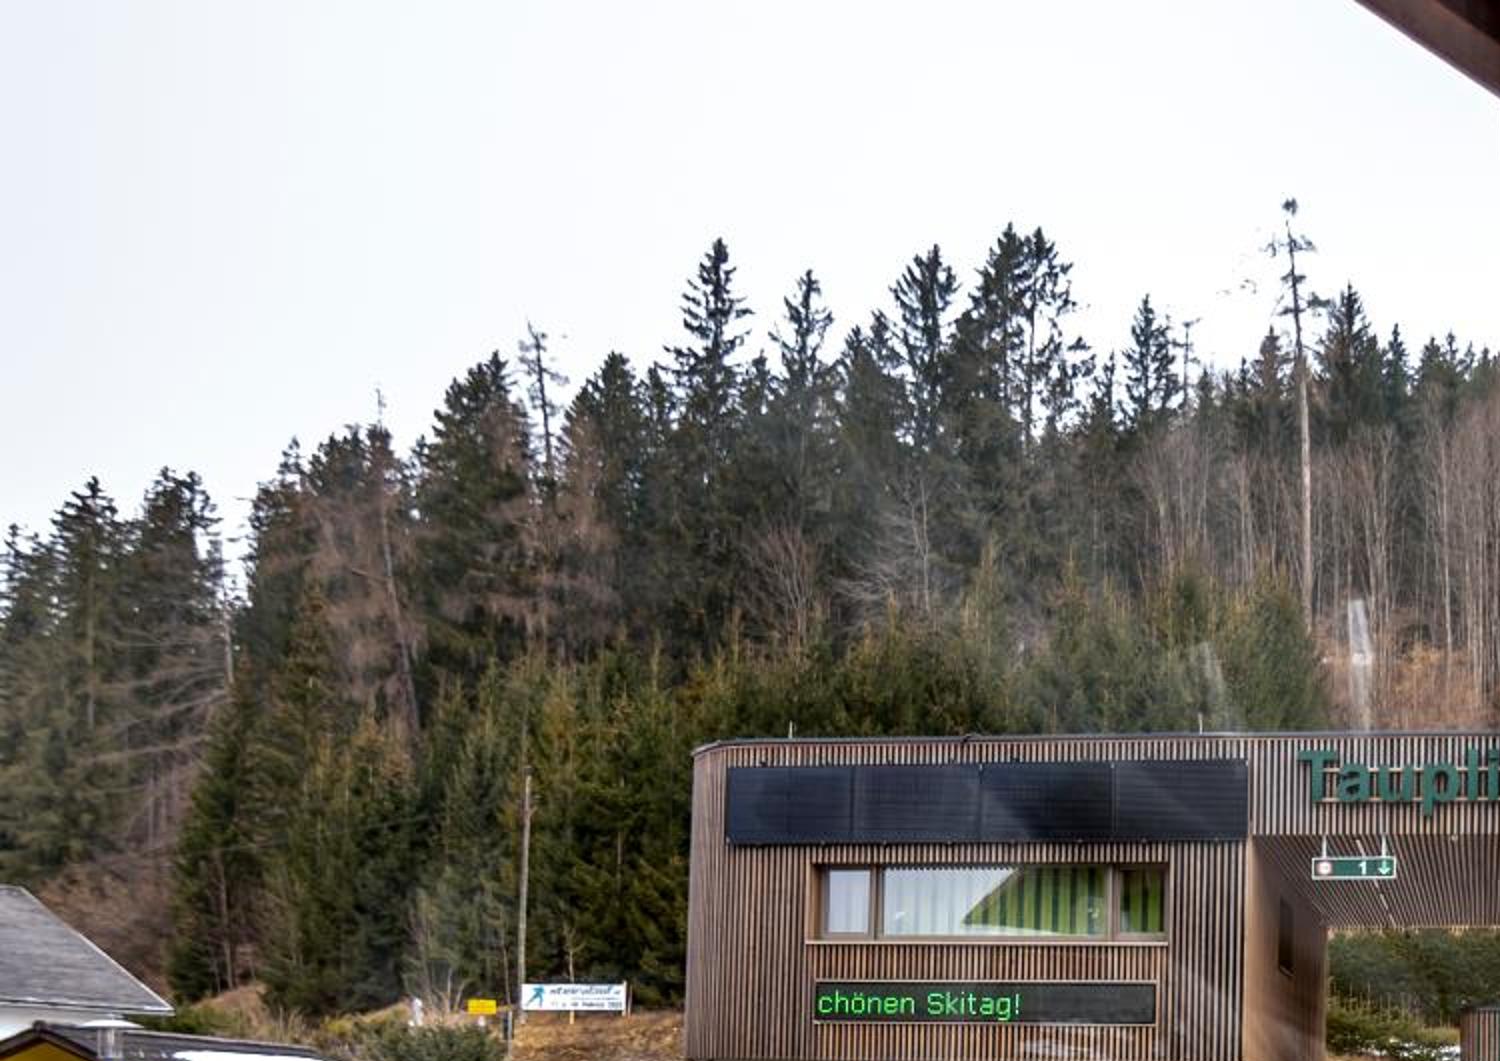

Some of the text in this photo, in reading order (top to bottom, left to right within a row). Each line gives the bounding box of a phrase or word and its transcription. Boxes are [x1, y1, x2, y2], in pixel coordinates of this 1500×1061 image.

[1357, 861, 1368, 875] 1
[818, 989, 1022, 1021] chönen Skitag!
